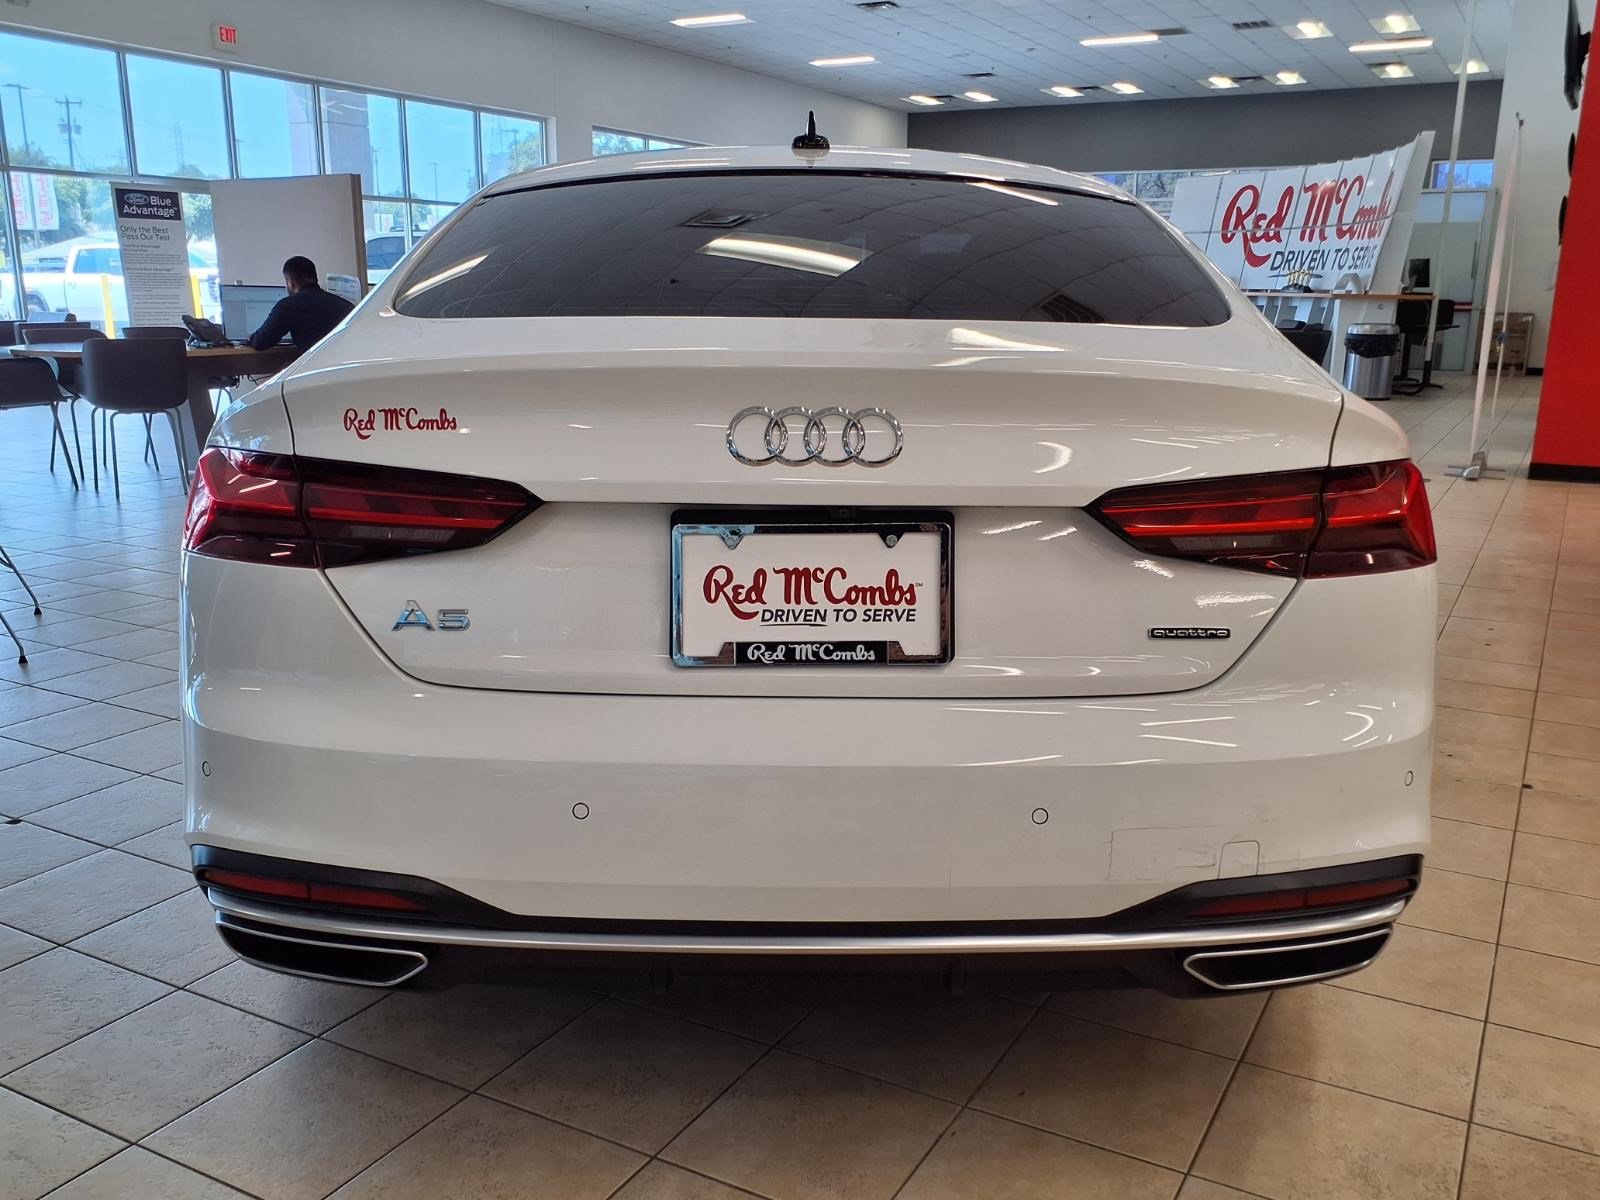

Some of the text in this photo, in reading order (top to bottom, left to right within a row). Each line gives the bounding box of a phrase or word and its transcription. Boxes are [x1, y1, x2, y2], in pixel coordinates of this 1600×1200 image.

[219, 26, 236, 44] EXIT
[150, 195, 172, 206] Blue
[123, 204, 176, 218] Advantage
[120, 225, 137, 234] Only
[152, 226, 169, 234] Best
[1221, 184, 1294, 268] Red
[121, 232, 170, 241] Pass Our Test
[1269, 248, 1331, 271] DRIVEN
[1331, 248, 1350, 271] TO
[343, 407, 458, 440] Red McCombs
[703, 565, 768, 620] Red
[772, 566, 917, 606] McCombs
[392, 599, 471, 631] A5
[760, 608, 917, 623] DRIVEN TO SERVE
[1153, 629, 1228, 637] quattro
[747, 643, 876, 663] Red McCombs
